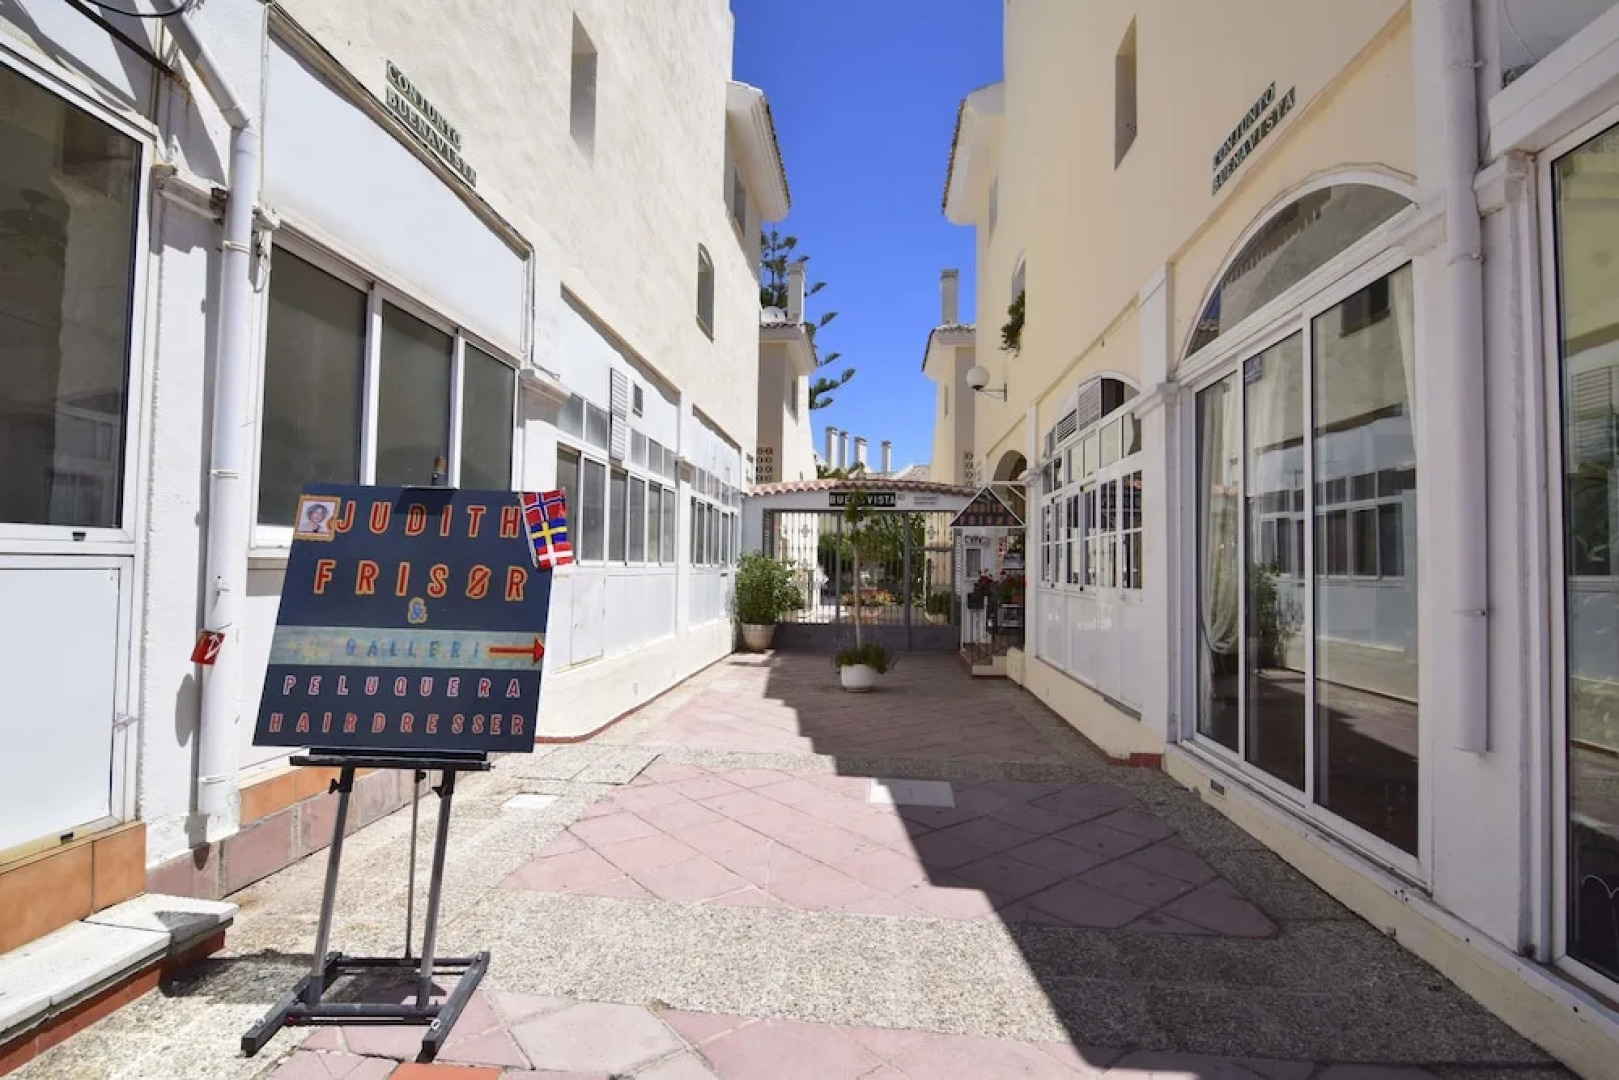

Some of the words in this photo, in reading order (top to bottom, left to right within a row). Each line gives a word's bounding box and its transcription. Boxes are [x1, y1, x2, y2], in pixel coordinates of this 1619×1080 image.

[829, 494, 895, 505] BUEVISTA
[335, 501, 520, 538] JUDITH
[313, 559, 527, 601] FRISØR
[407, 597, 427, 623] &
[345, 638, 480, 659] GALLERI
[283, 675, 520, 698] PELUQUERA
[269, 712, 523, 735] HAIRDRESSER
